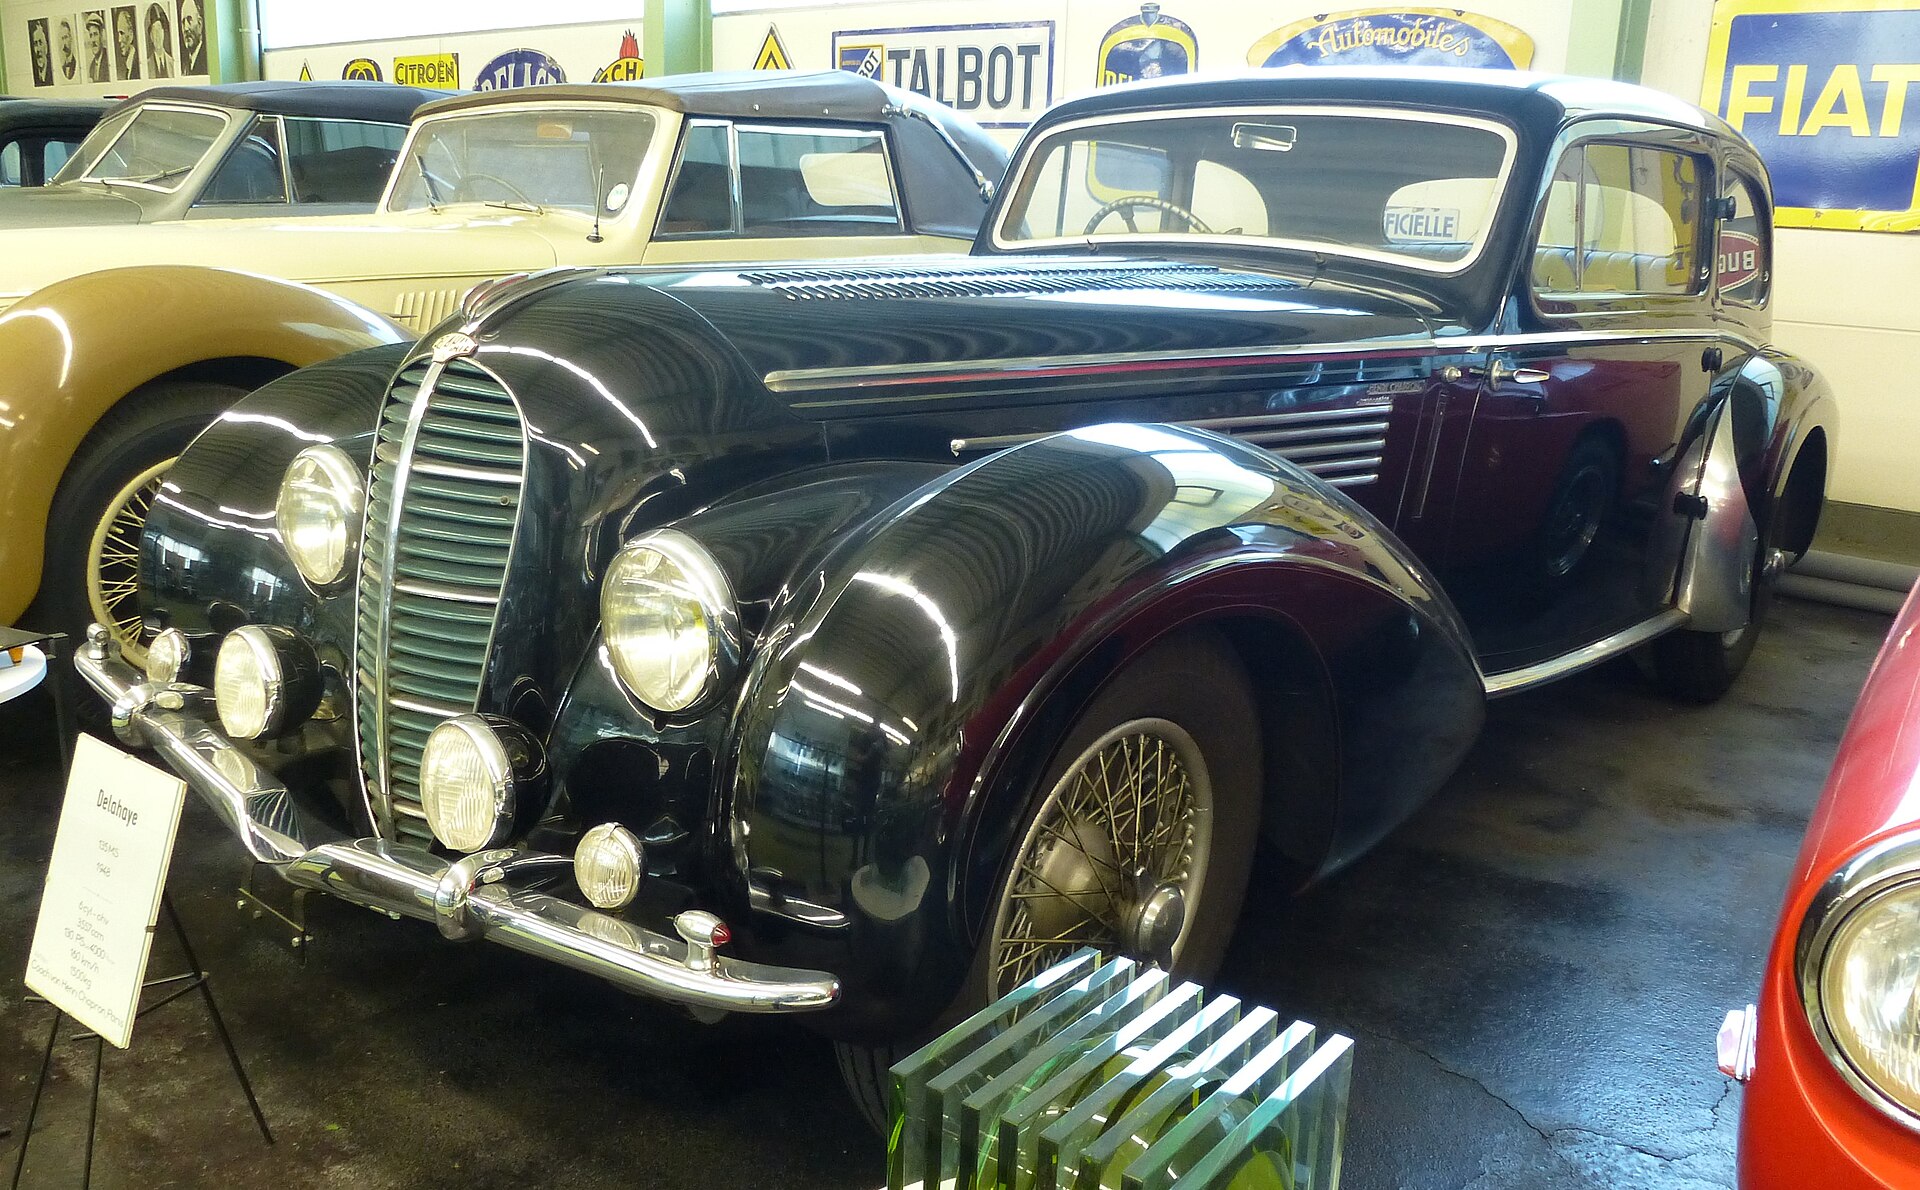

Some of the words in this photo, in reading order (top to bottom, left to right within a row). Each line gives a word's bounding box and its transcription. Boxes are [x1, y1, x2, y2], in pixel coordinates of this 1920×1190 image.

[1307, 18, 1470, 58] Automobiles
[395, 60, 456, 86] CITROËN
[887, 44, 1041, 110] TALBOT
[1725, 64, 1920, 138] FIAT
[97, 788, 138, 827] Delahaye
